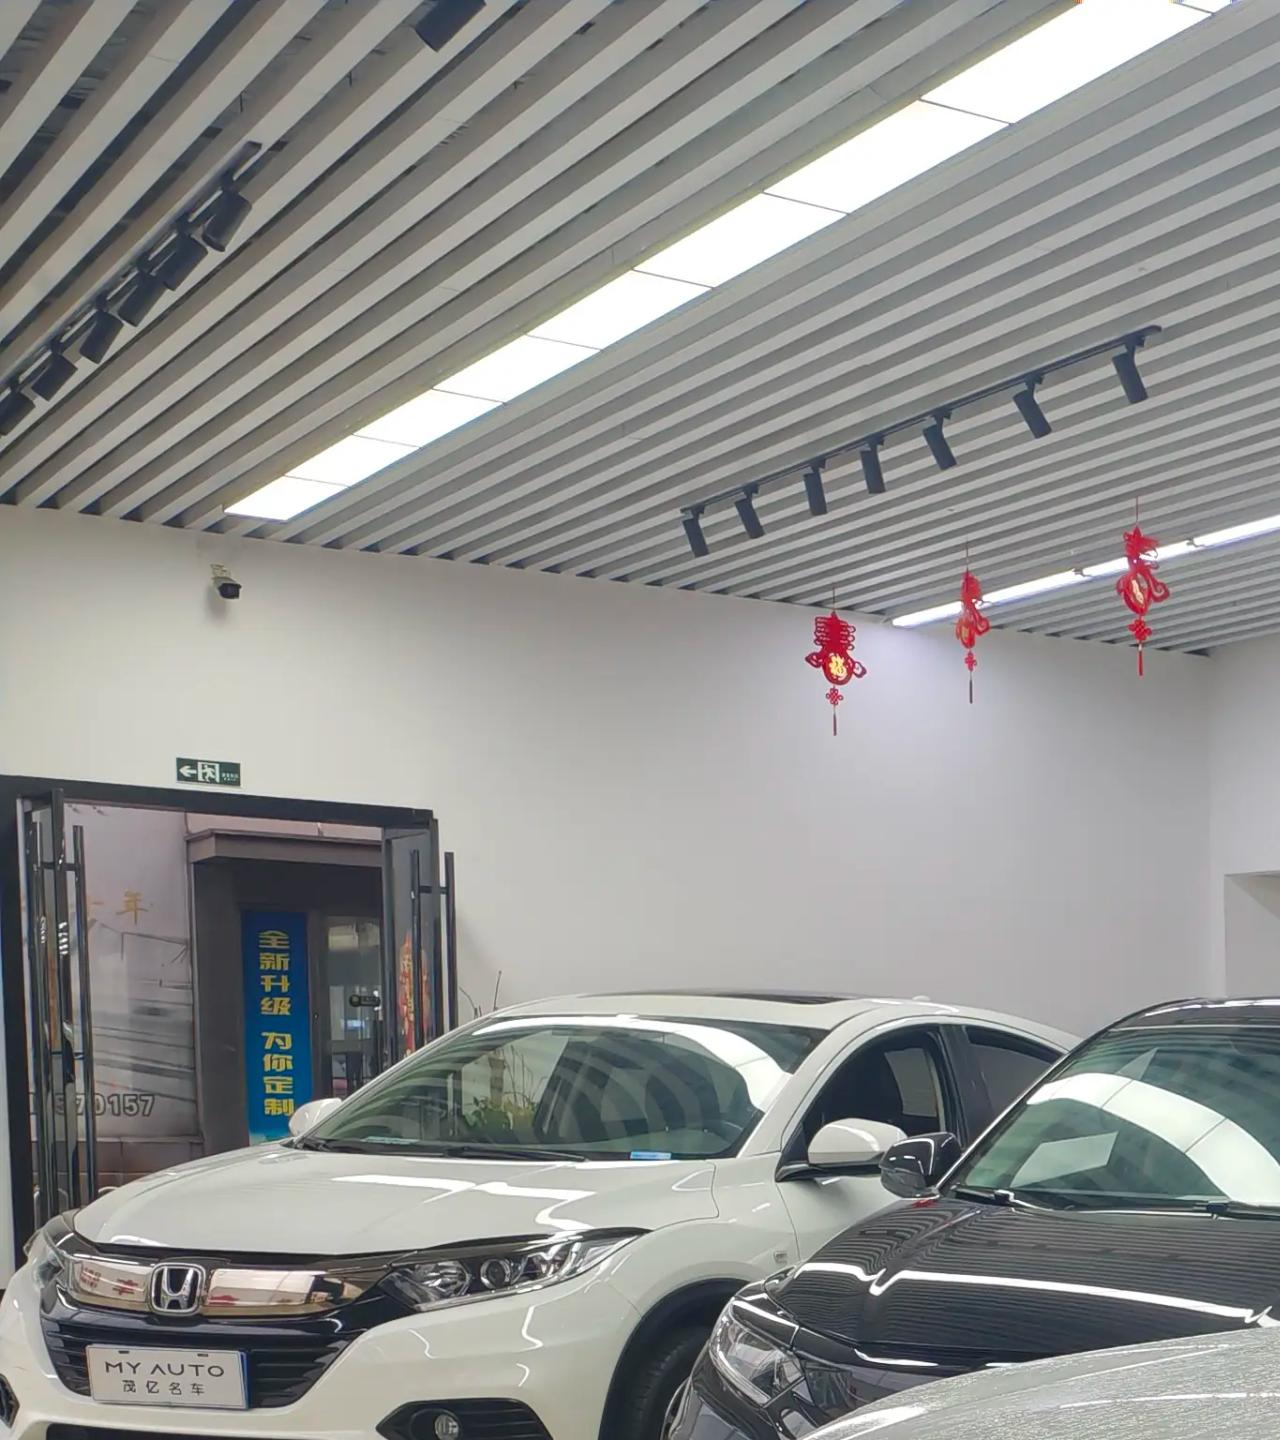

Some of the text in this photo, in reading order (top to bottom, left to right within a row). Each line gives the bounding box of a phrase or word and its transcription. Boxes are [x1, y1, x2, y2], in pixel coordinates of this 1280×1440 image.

[258, 930, 295, 1116] 全新升级 为你定制
[105, 1361, 224, 1378] MY AUTO
[121, 1379, 206, 1396] 茂亿名车
